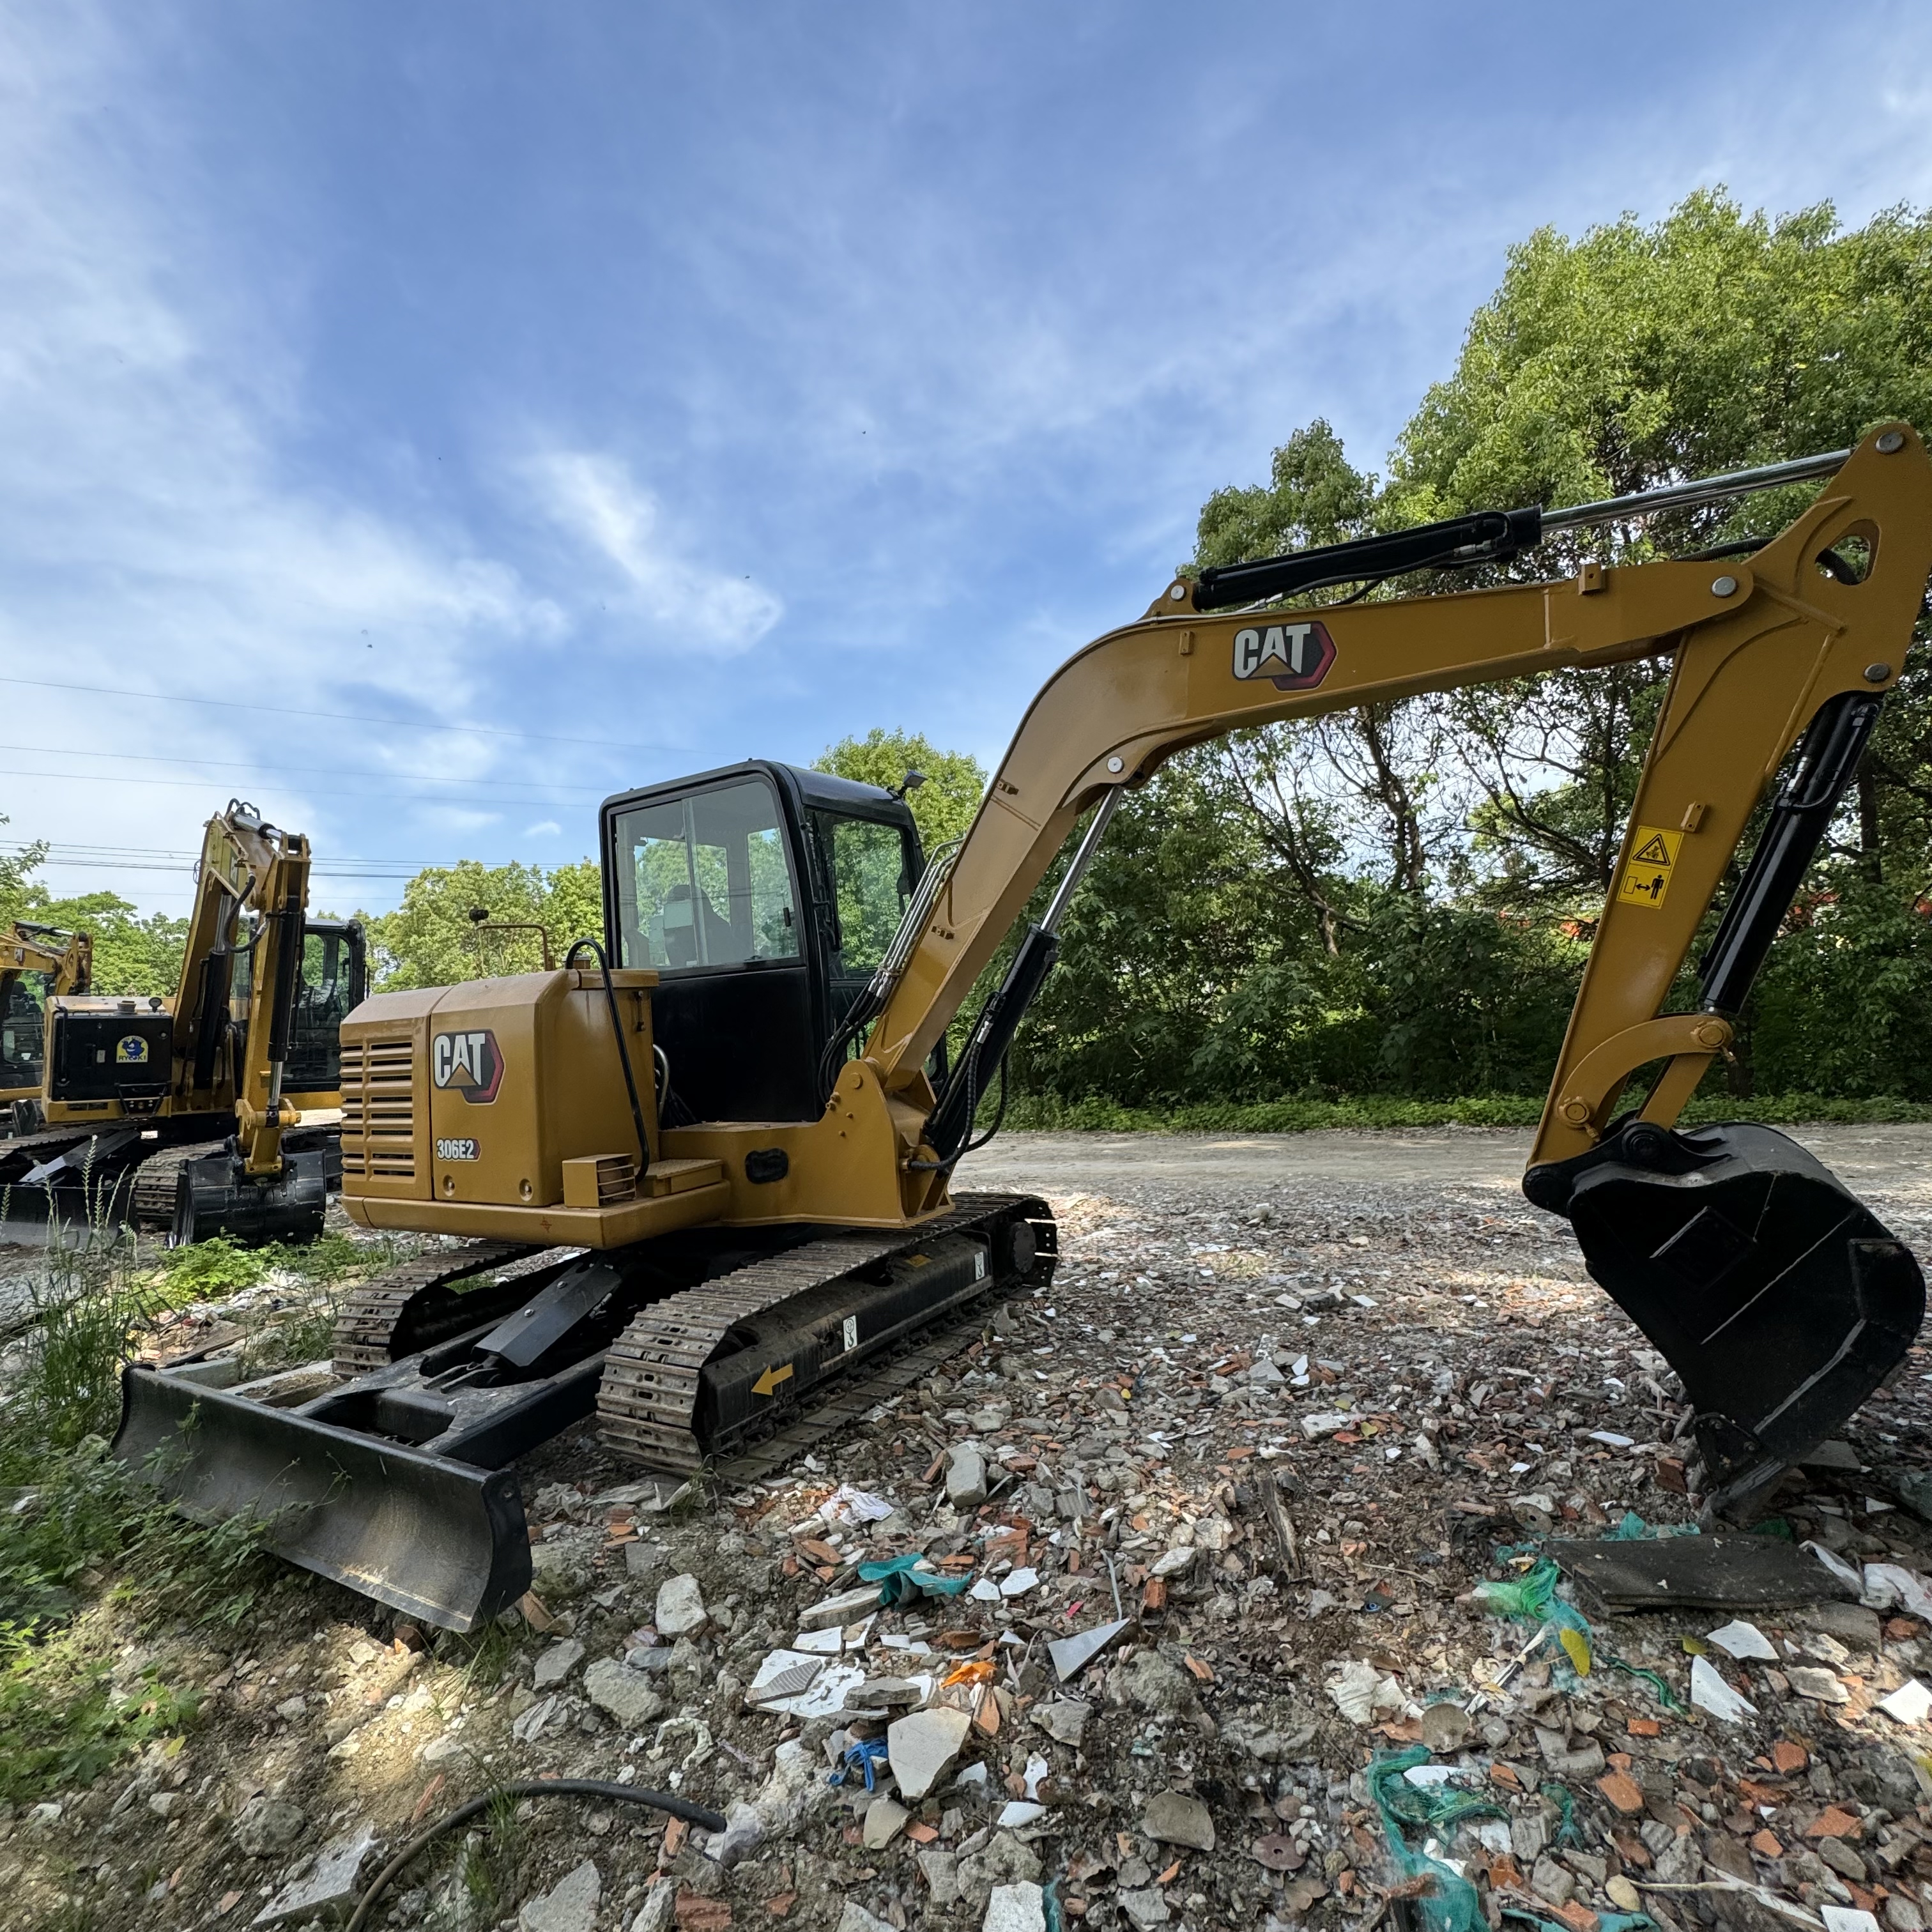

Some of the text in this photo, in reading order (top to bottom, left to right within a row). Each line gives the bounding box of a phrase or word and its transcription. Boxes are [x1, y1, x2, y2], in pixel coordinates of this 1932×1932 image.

[1234, 624, 1311, 678] CAT
[434, 1033, 485, 1087] CAT
[437, 1139, 475, 1159] 306E2
